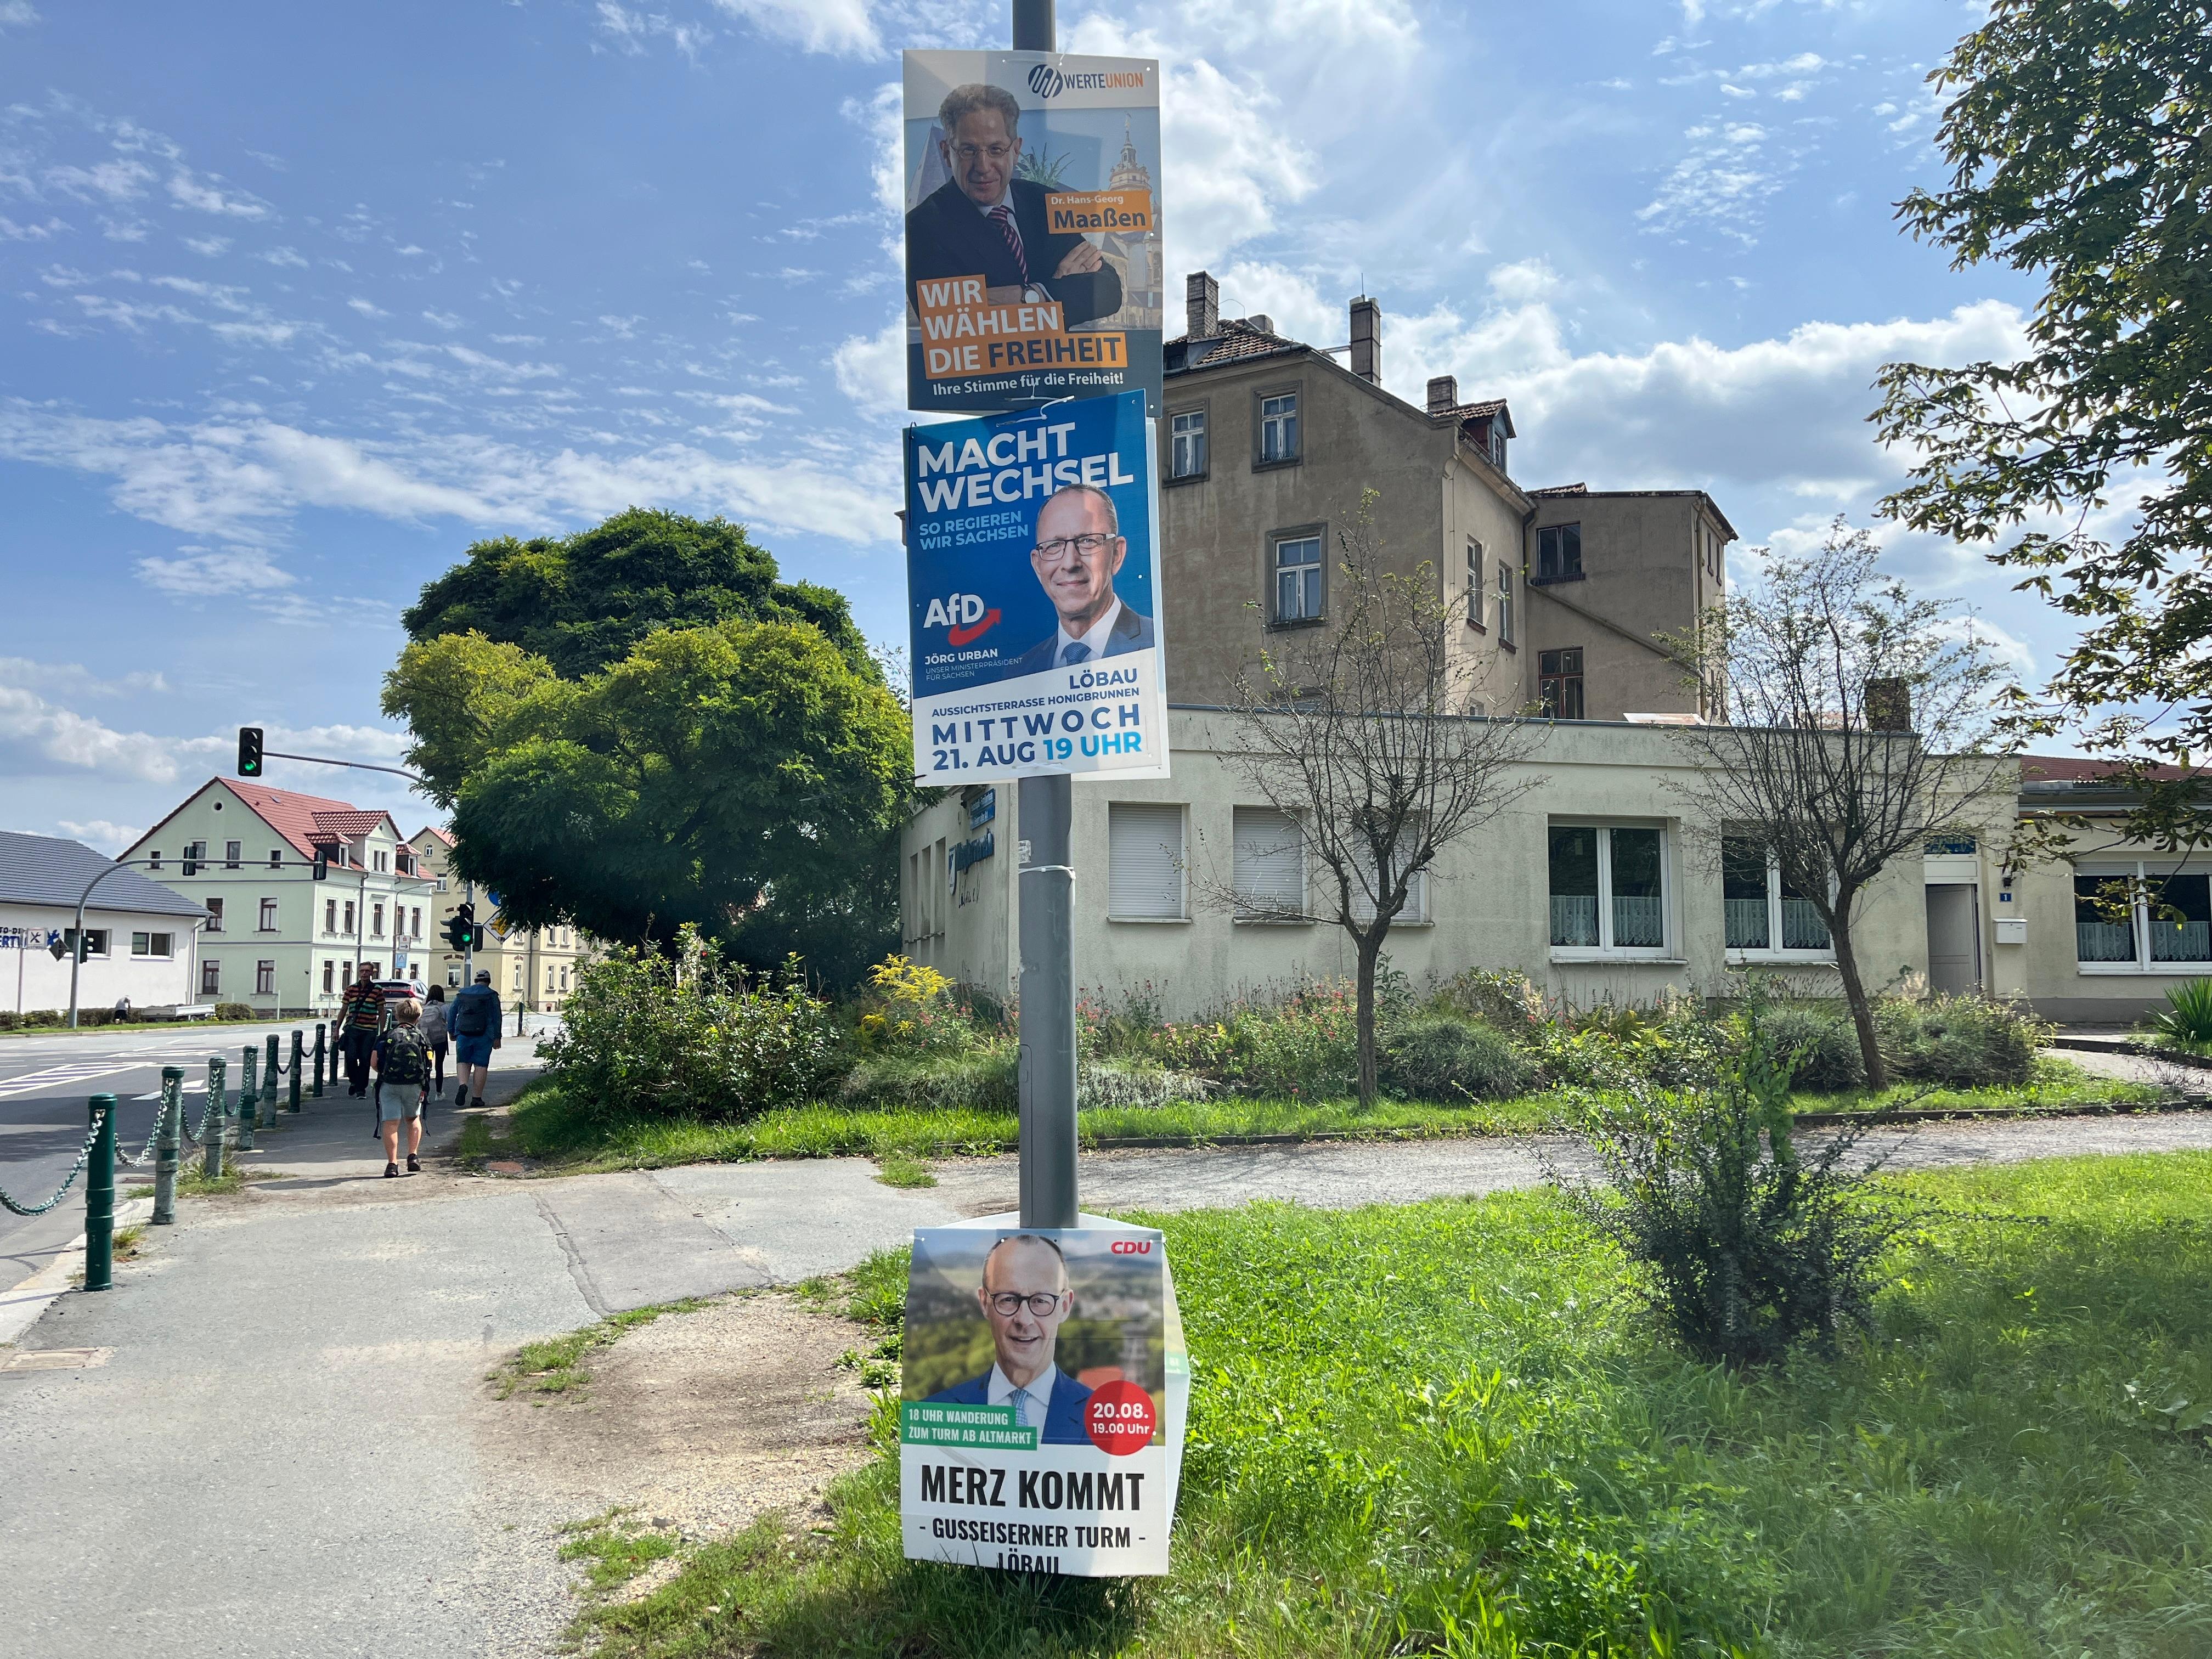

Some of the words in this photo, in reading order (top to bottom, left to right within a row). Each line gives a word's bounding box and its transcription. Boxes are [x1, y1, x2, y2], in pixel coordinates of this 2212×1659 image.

[1064, 72, 1144, 89] WERTEUNION
[1051, 196, 1065, 205] Dr.
[1067, 195, 1124, 205] Hans-Georg
[1054, 207, 1146, 229] Maaßen
[920, 280, 983, 308] WIR
[924, 306, 1059, 341] WÄHLEN
[928, 345, 981, 374] DIE
[988, 337, 1121, 368] FREIHEIT
[933, 383, 961, 396] Ihre
[964, 378, 1017, 394] Stimme
[1020, 374, 1041, 388] für
[1044, 373, 1064, 386] die
[1068, 372, 1124, 385] Freiheit!
[918, 422, 1076, 478] MACHT
[917, 452, 1134, 513] WECHSEL
[919, 522, 940, 537] SO
[945, 510, 1022, 532] REGIEREN
[919, 537, 952, 550] WIR
[956, 524, 1029, 546] SACHSEN
[923, 592, 985, 628] AfD
[924, 653, 955, 665] JÖRG
[958, 648, 998, 661] URBAN
[926, 665, 950, 674] UNSER
[951, 657, 1023, 671] MINISTERPRÄSIDENT
[941, 670, 975, 680] SACHSEN
[1069, 668, 1138, 690] LÖBAU
[932, 697, 1045, 717] AUSSICHTSTERRASSE
[1048, 687, 1139, 705] HONIGBRUNNEN
[932, 703, 1139, 745] MITTWOCH
[933, 749, 968, 770] 21.
[977, 741, 1035, 767] AUG
[1043, 738, 1073, 760] 19
[1080, 731, 1142, 757] UHR
[1110, 1241, 1152, 1255] CDU
[909, 1408, 920, 1422] 18
[922, 1409, 944, 1424] UHR
[946, 1411, 1008, 1426] WANDERUNG
[1093, 1402, 1149, 1419] 20.08.
[909, 1426, 929, 1440] ZUM
[932, 1428, 959, 1442] TURM
[962, 1430, 977, 1443] AB
[979, 1431, 1032, 1444] ALTMARKT
[1092, 1423, 1125, 1434] 19.00
[1127, 1423, 1150, 1435] Uhr
[921, 1464, 1006, 1507] MERZ
[1018, 1470, 1144, 1511] KOMMT
[933, 1518, 1069, 1548] GUSSEISERNER
[1075, 1526, 1131, 1549] TURM
